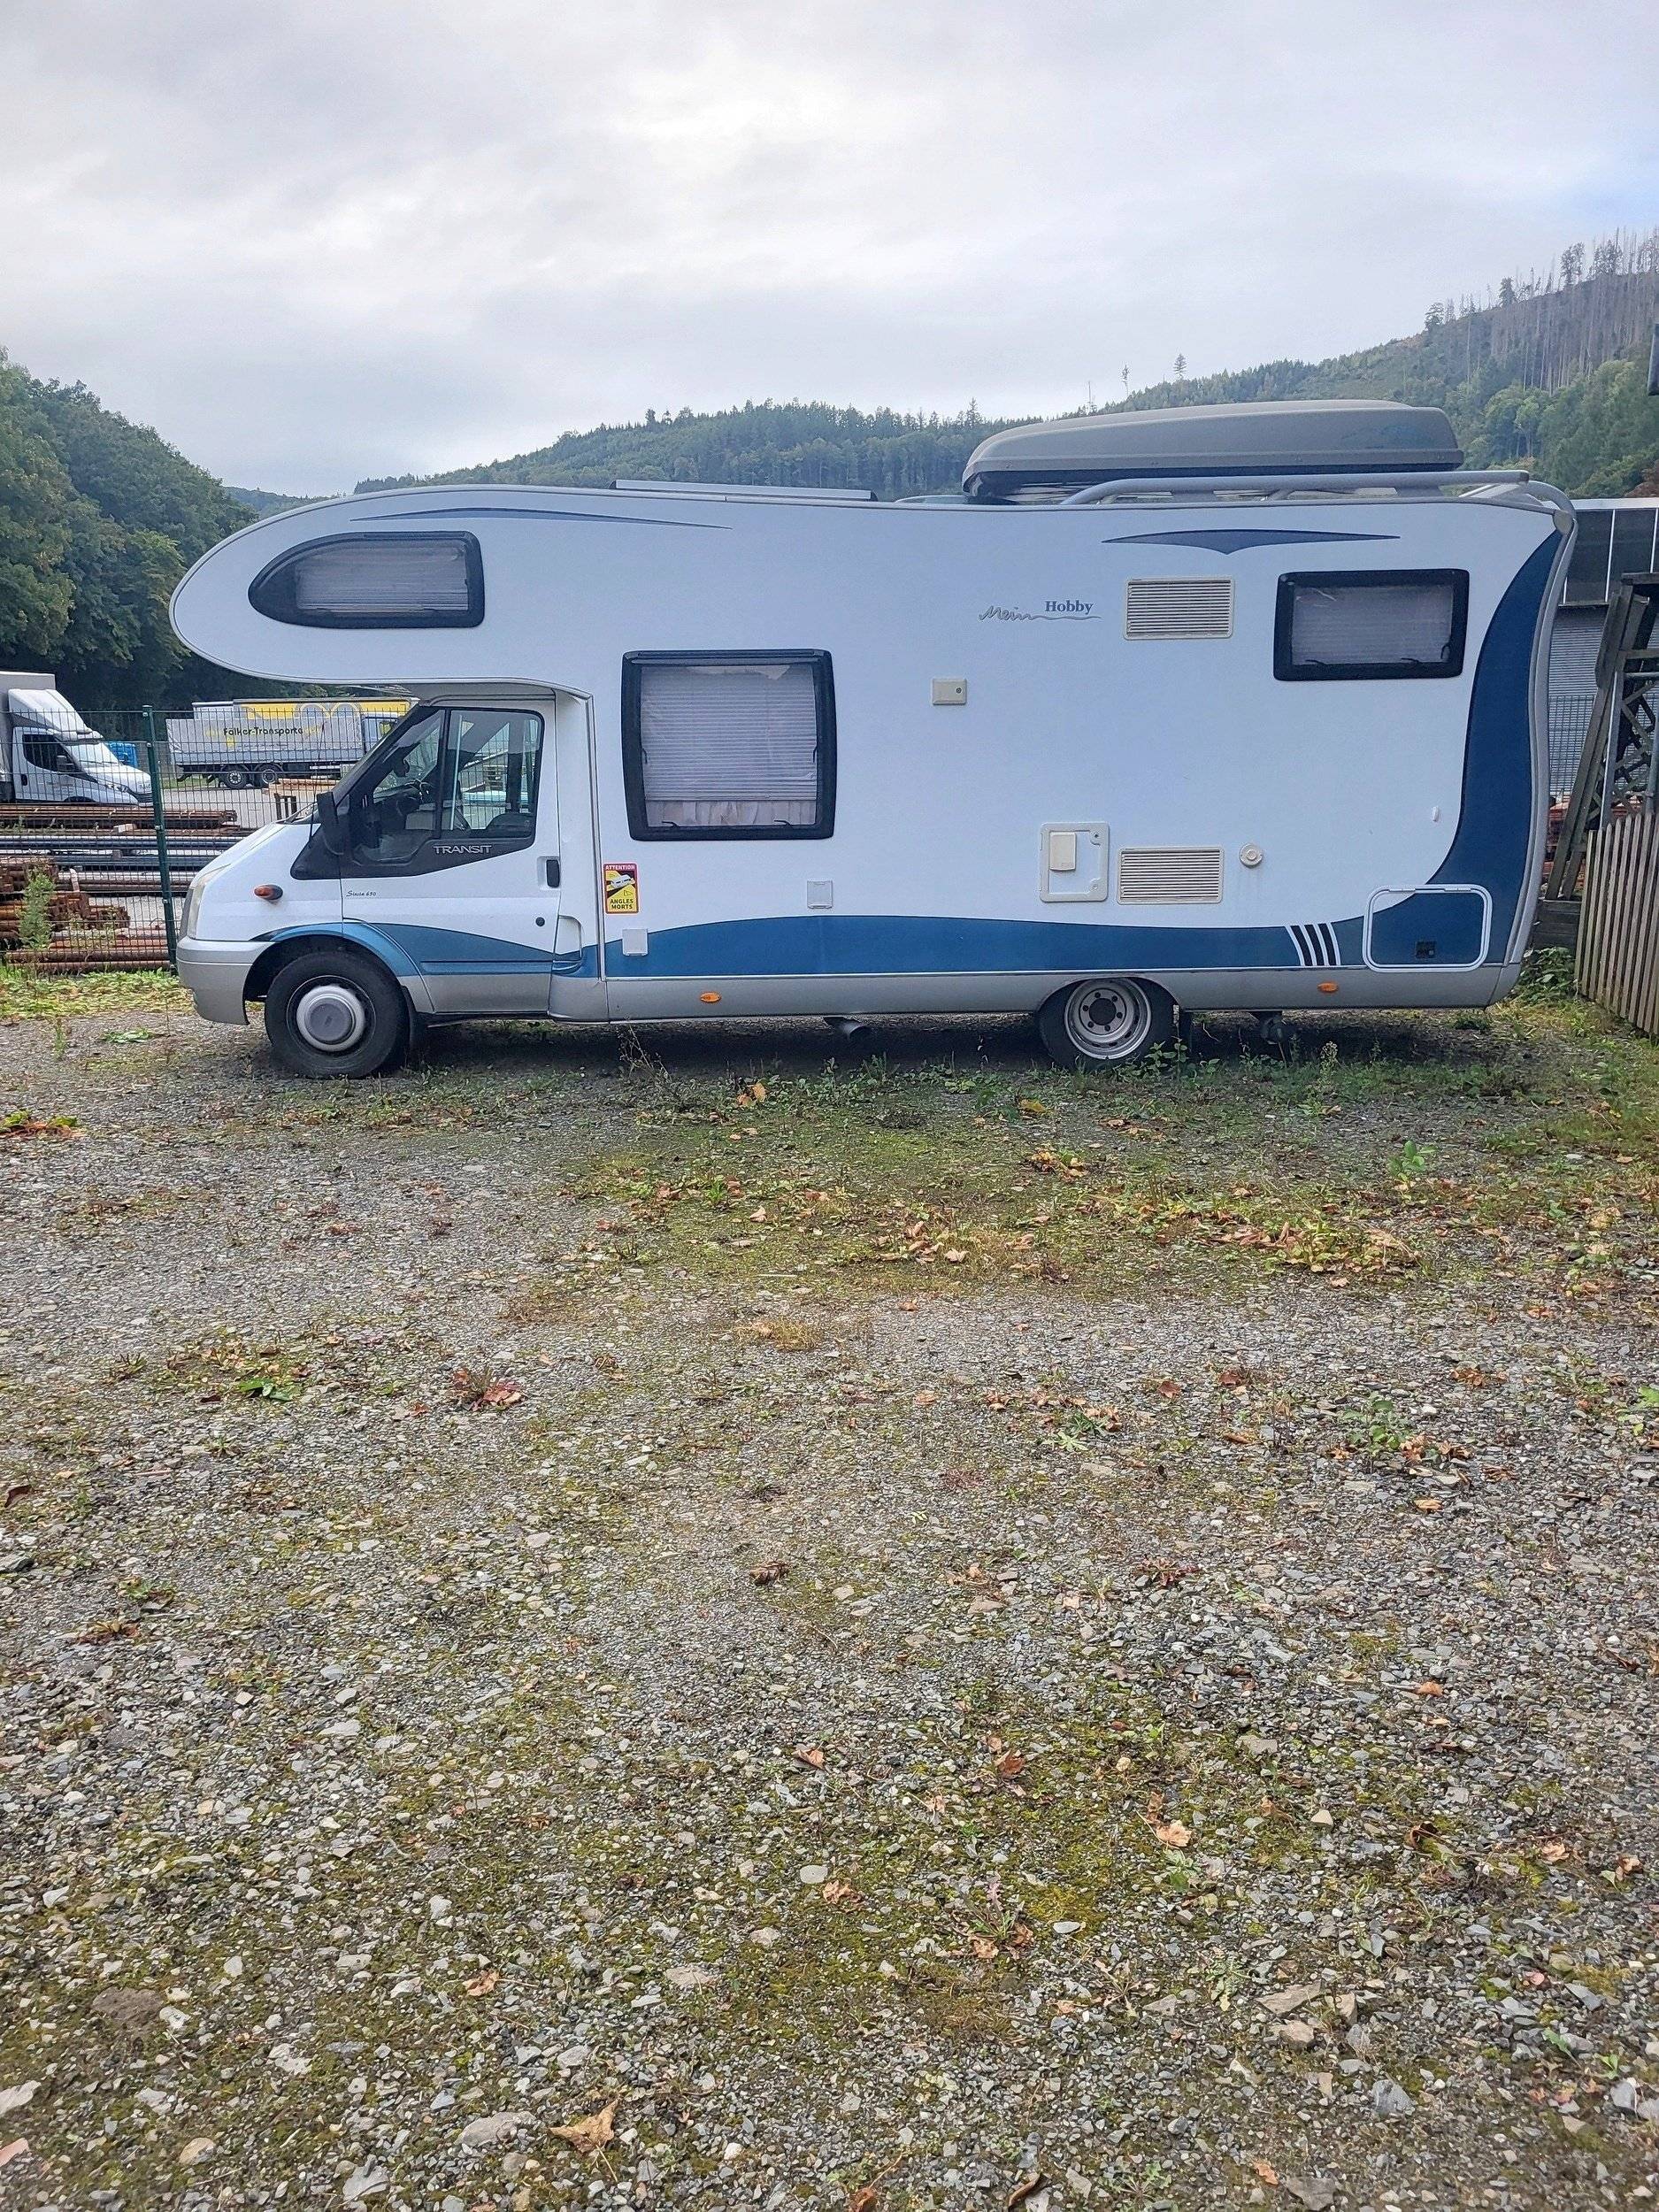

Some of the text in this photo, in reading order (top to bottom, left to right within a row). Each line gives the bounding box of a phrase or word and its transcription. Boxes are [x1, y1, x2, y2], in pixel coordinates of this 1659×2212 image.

[978, 605, 1033, 621] Mein
[1044, 599, 1094, 615] Hobby
[433, 845, 492, 854] TRANSIT
